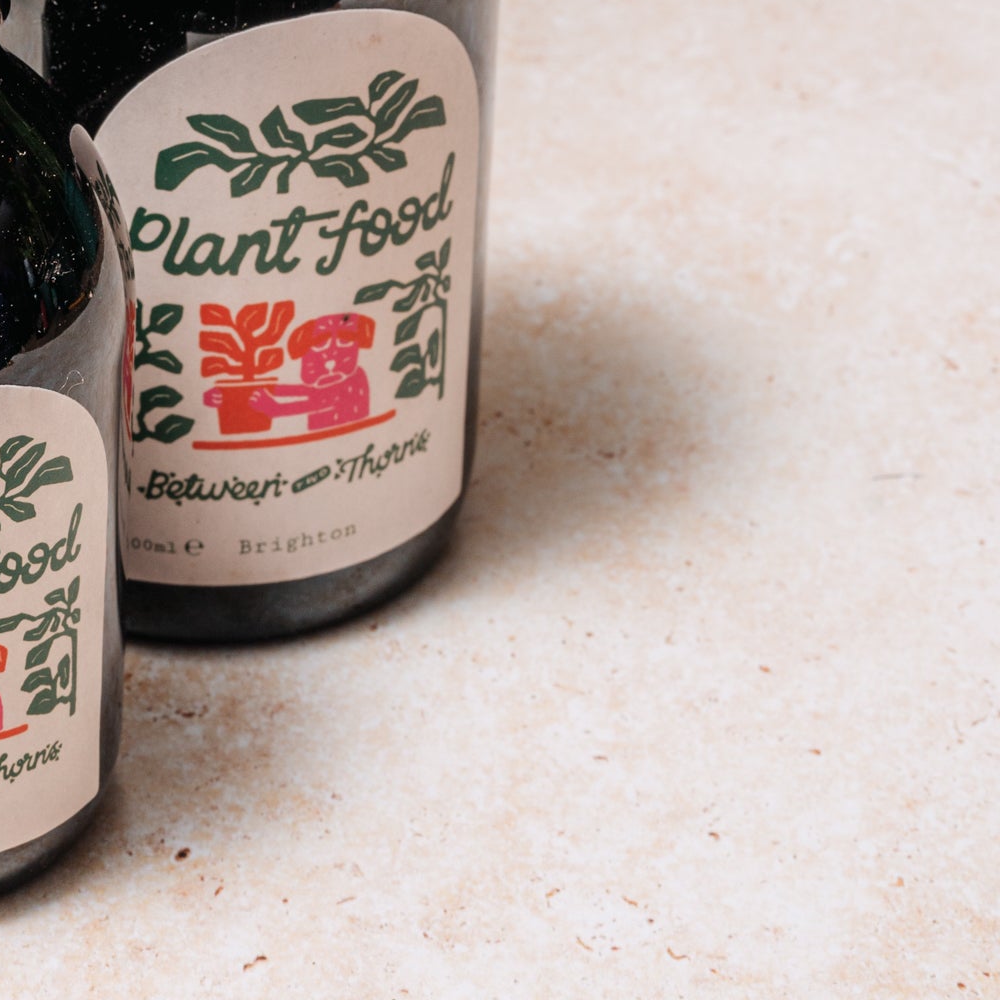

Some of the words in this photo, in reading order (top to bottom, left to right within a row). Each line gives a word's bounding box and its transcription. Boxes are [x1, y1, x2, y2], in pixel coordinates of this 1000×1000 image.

[129, 206, 340, 276] Plant
[315, 151, 455, 276] food
[144, 469, 283, 501] Between
[130, 537, 176, 554] 00ml
[239, 523, 357, 556] Brighton
